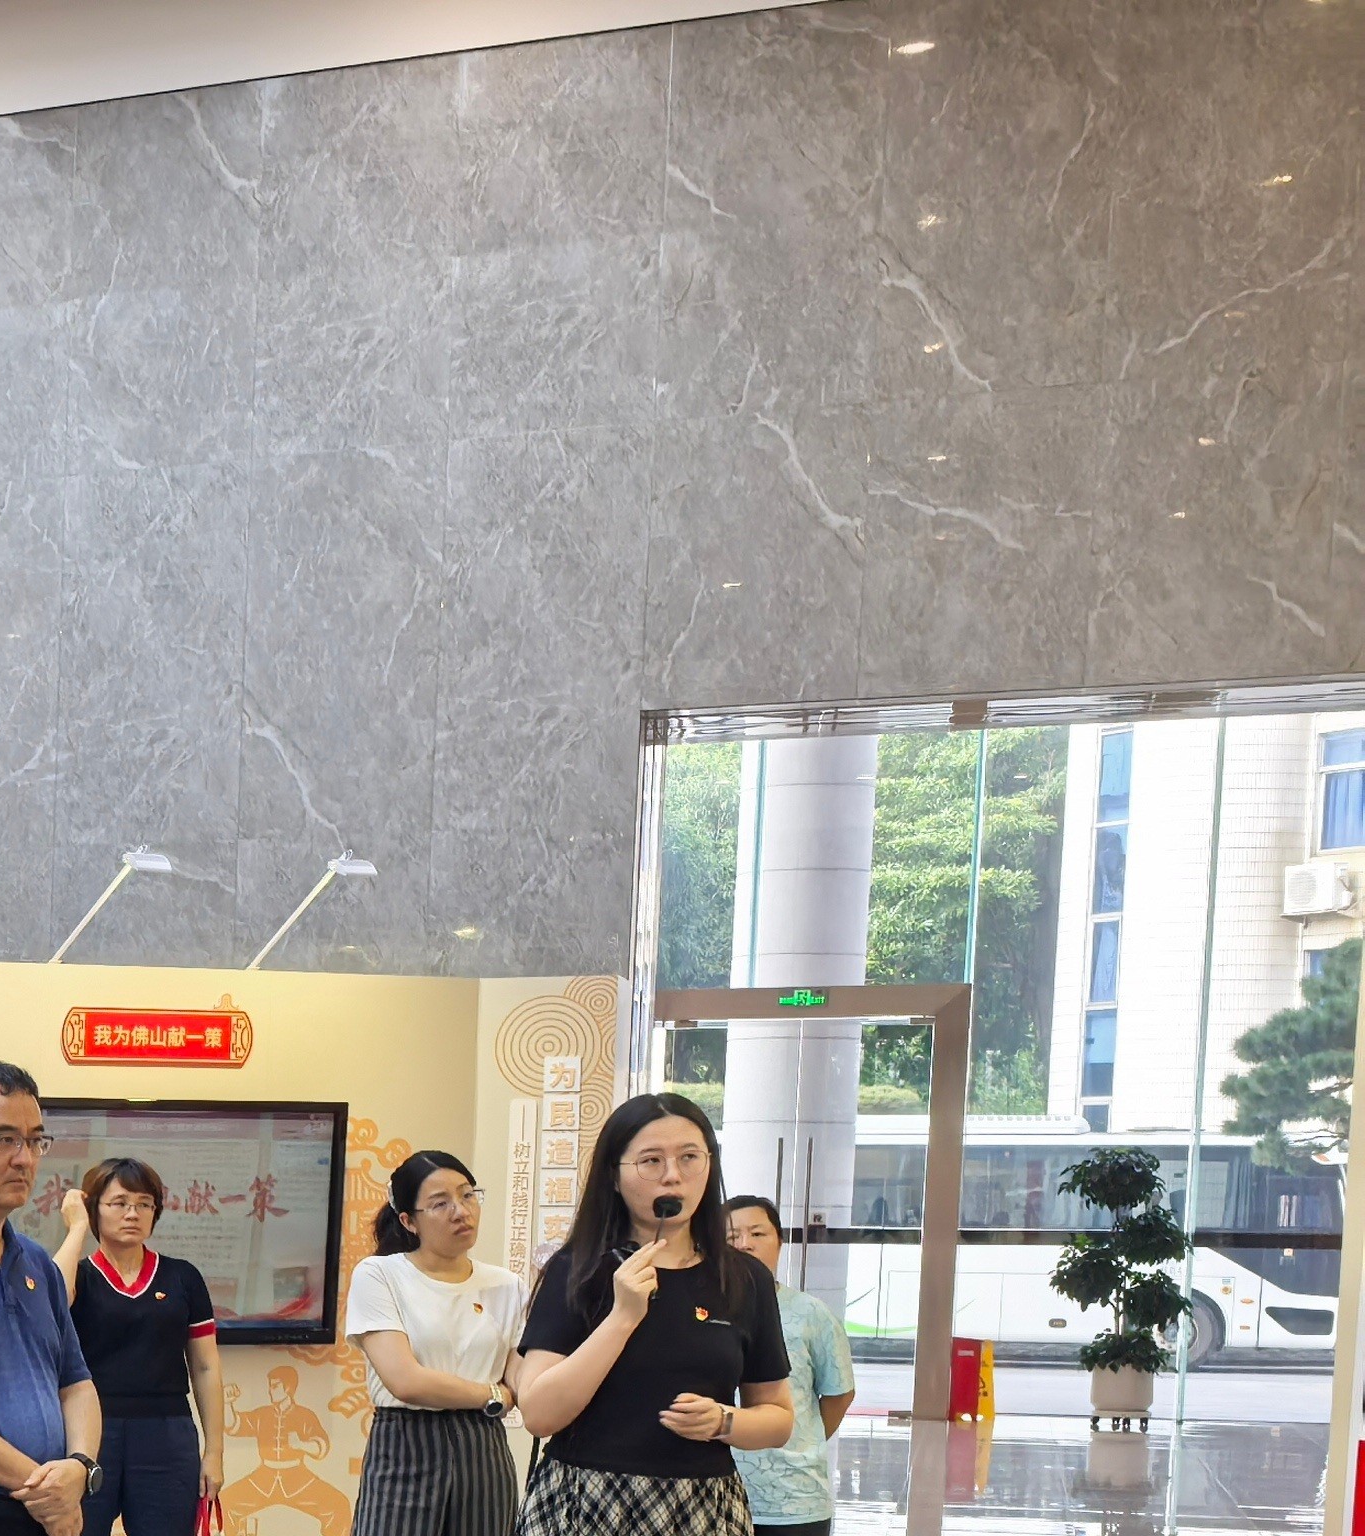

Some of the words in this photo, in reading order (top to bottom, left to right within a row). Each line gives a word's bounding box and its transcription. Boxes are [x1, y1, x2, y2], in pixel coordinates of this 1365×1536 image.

[93, 1023, 224, 1050] 我为佛山献一策
